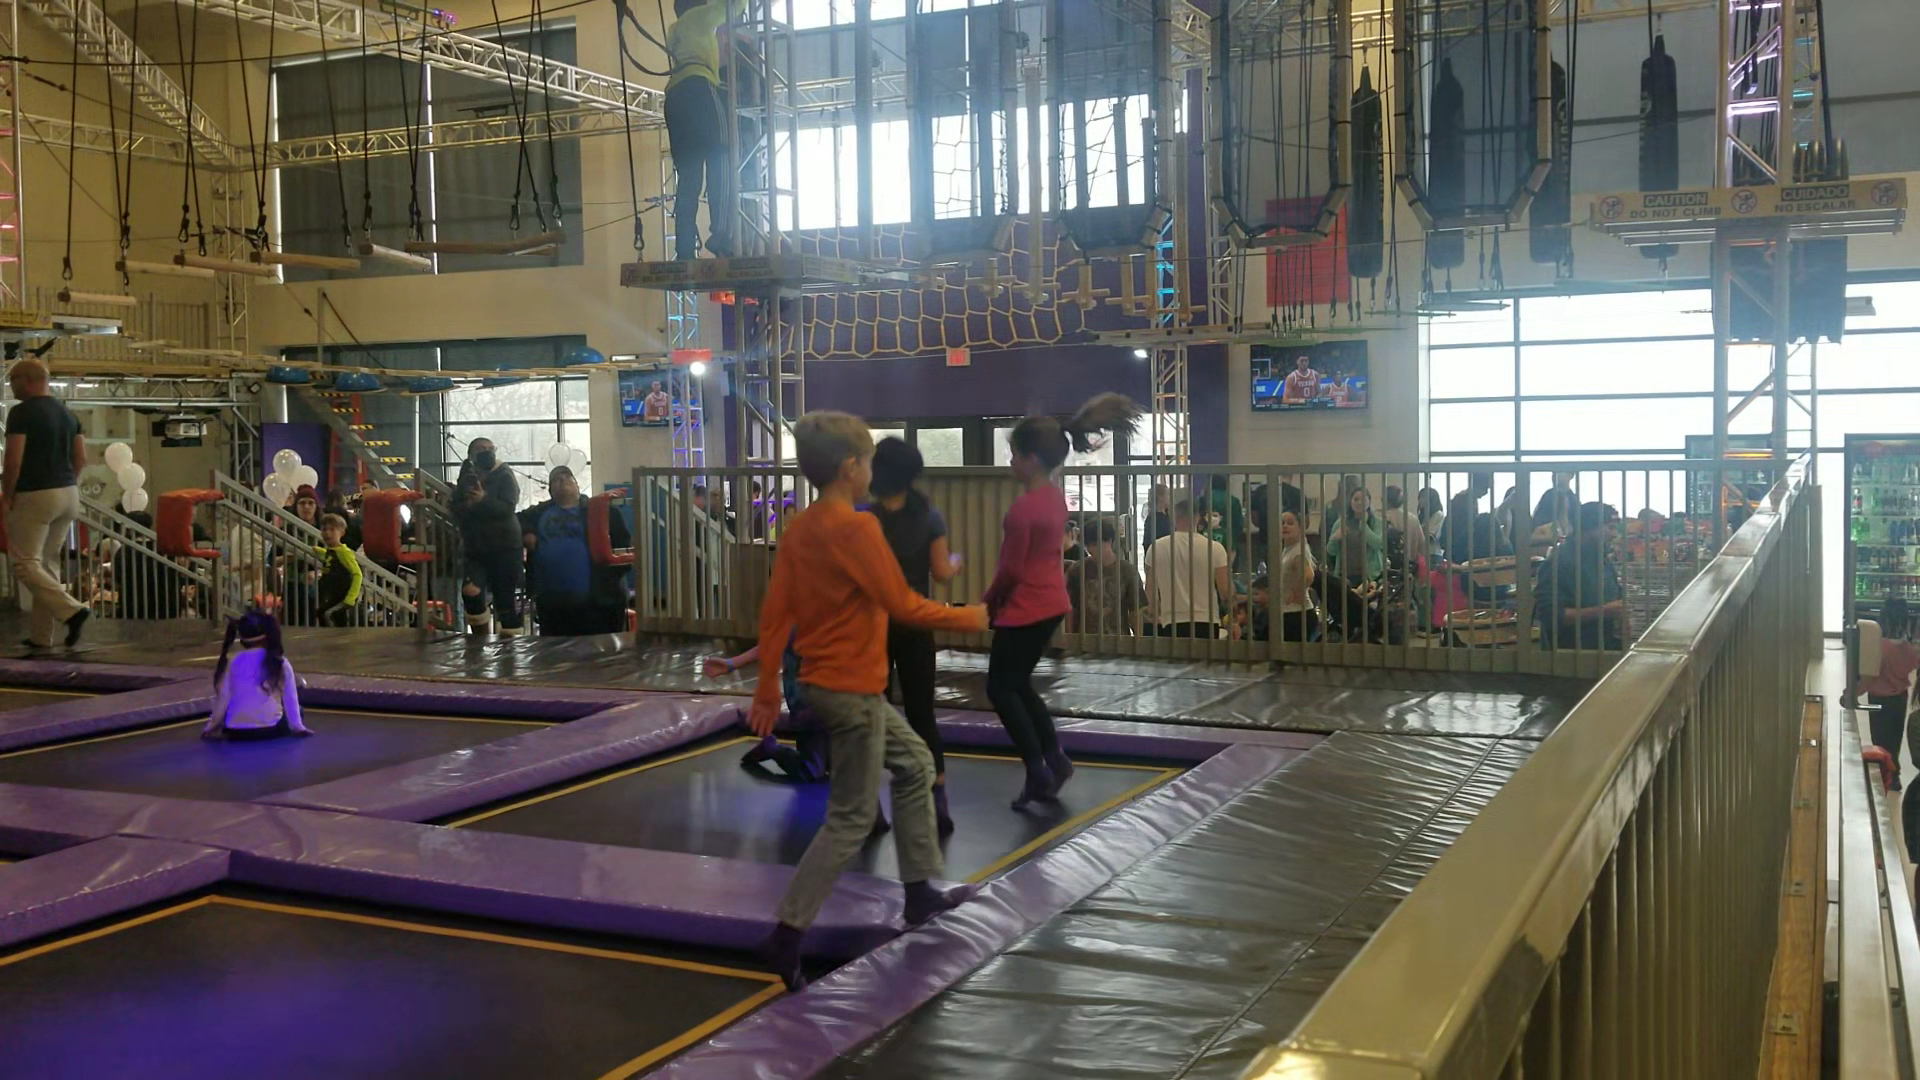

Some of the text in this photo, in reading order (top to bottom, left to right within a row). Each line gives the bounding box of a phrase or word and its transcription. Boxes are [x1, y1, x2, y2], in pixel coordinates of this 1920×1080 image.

[1782, 185, 1848, 200] CUIDADO
[1645, 193, 1707, 207] CAUTION
[1630, 206, 1721, 219] DO NOT CLIMB
[1774, 203, 1794, 212] NO
